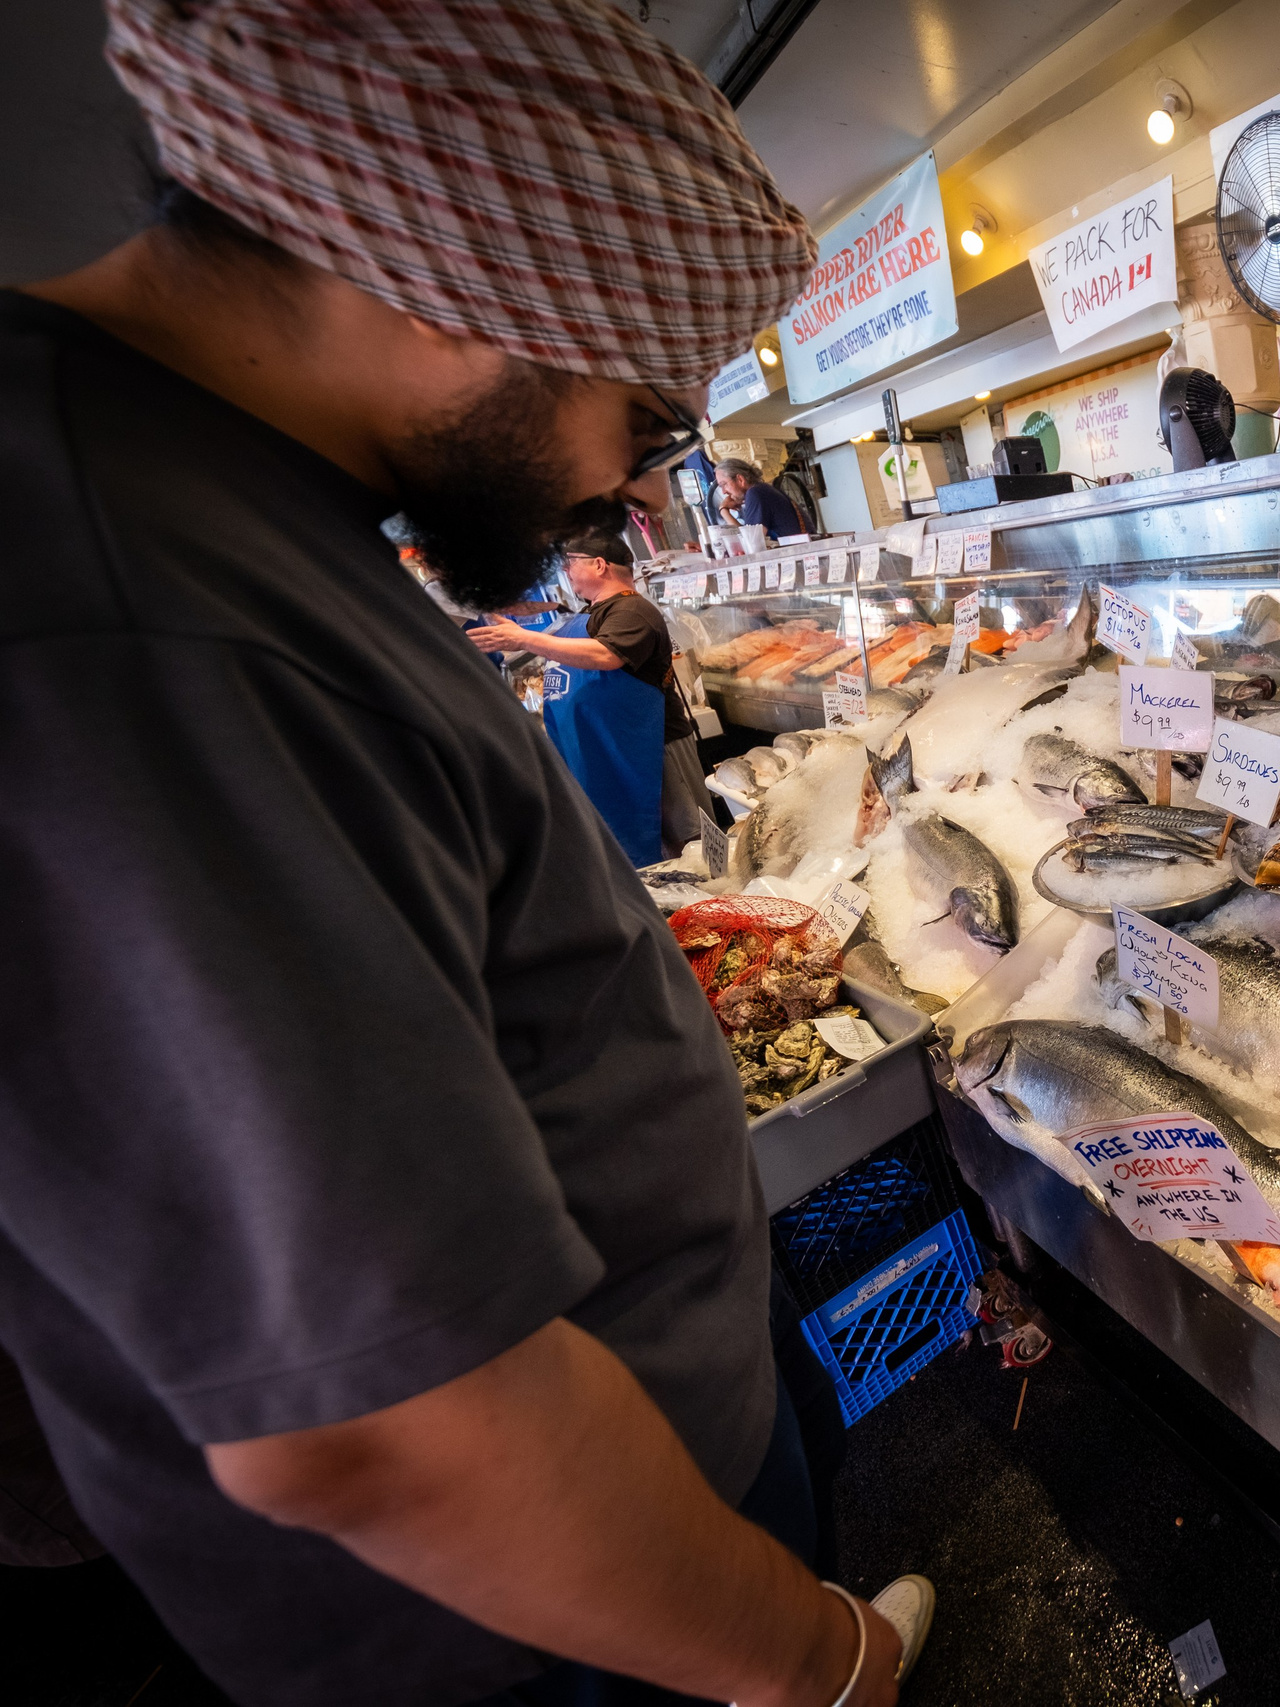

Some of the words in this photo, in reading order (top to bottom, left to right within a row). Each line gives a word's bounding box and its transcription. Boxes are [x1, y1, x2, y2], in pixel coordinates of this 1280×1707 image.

[854, 203, 909, 268] RIVER
[1036, 247, 1058, 288] WE
[1065, 222, 1115, 275] PACK
[1122, 199, 1162, 248] FOR
[792, 287, 846, 345] SALMON
[848, 263, 881, 309] ARE
[878, 226, 940, 288] HERE
[1062, 266, 1122, 324] CANADA
[816, 349, 830, 372] GET
[827, 336, 850, 366] YOURS
[844, 322, 873, 356] BEFORE
[869, 303, 906, 341] THEY'RE
[904, 290, 932, 323] GONE
[1078, 395, 1093, 412] WE
[1097, 387, 1118, 407] SHIP
[1075, 403, 1129, 432] ANYWHERE
[1101, 425, 1119, 443] THE
[1091, 446, 1118, 463] U.S.A.
[1104, 598, 1147, 632] OCTOPUS
[1115, 594, 1130, 606] WILD
[545, 676, 561, 688] FISH
[1117, 911, 1157, 945] FRESH
[1167, 938, 1206, 973] LOCAL
[1120, 933, 1158, 964] WHOLE
[1170, 960, 1207, 992] KING
[1134, 958, 1187, 995] SALMON
[1074, 1136, 1133, 1167] FREE
[1133, 1128, 1227, 1150] SHIPPING
[1114, 1157, 1213, 1180] OVERNIGHT
[1136, 1188, 1219, 1208] ANYWHERE
[1220, 1189, 1242, 1203] IN
[1160, 1208, 1191, 1221] THE
[1193, 1206, 1220, 1223] US
